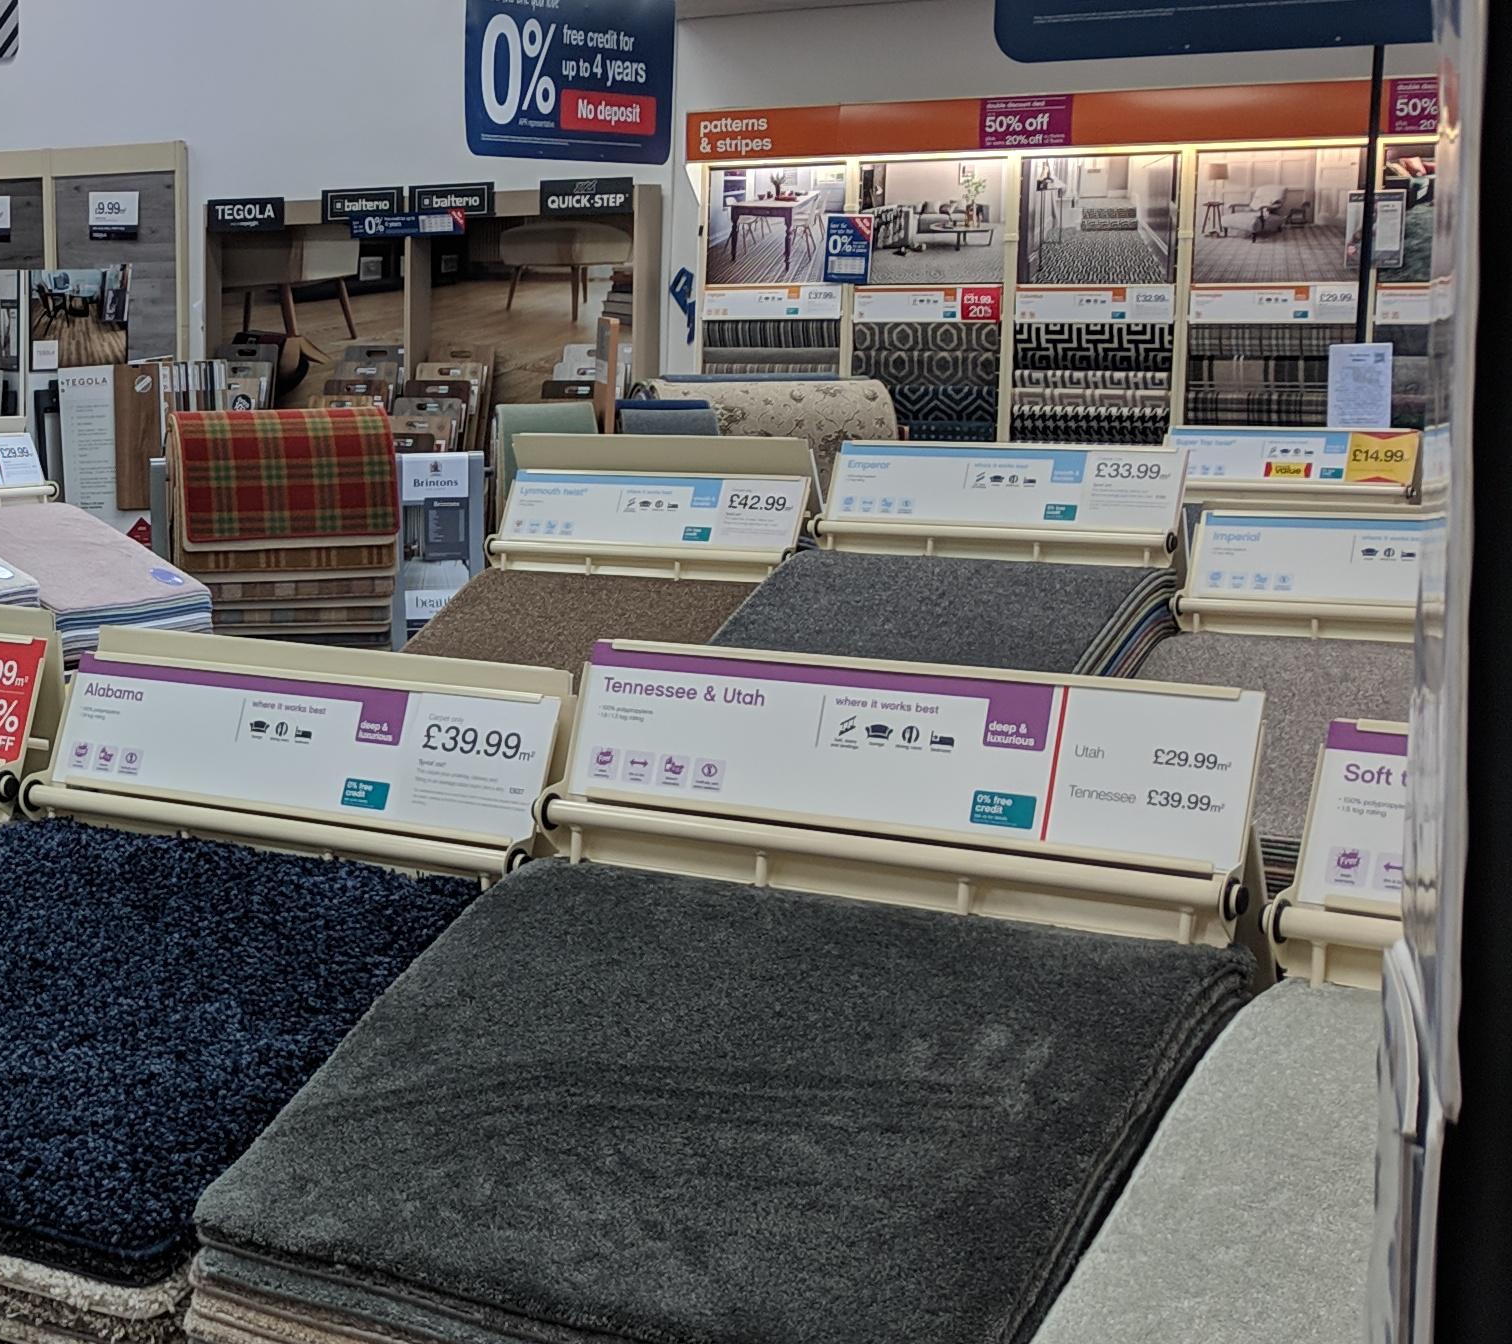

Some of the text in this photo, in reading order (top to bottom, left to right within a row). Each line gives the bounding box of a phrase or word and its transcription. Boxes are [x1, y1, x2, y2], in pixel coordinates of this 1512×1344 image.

[563, 24, 635, 52] free credit for
[480, 13, 557, 125] 0%
[562, 59, 646, 87] up to years
[577, 98, 641, 126] No deposit
[1395, 97, 1439, 116] 50%
[699, 117, 768, 138] patterns
[985, 112, 1050, 133] 50% off
[699, 135, 773, 156] & stripes
[1005, 135, 1028, 145] 20%
[344, 197, 390, 212] balterio
[432, 195, 480, 208] balterio
[215, 203, 275, 221] TEGOLA
[828, 234, 853, 255] 0%
[65, 375, 108, 387] TEGOLA
[847, 460, 890, 471] Emperor
[1213, 531, 1261, 543] Imperial
[83, 681, 144, 702] Alabama
[602, 676, 766, 707] Tennessee & Utah
[988, 720, 1017, 735] deep
[1074, 744, 1105, 760] Utah
[1343, 763, 1394, 787] Soft
[976, 794, 991, 804] 0%
[1068, 784, 1137, 804] Tennessee
